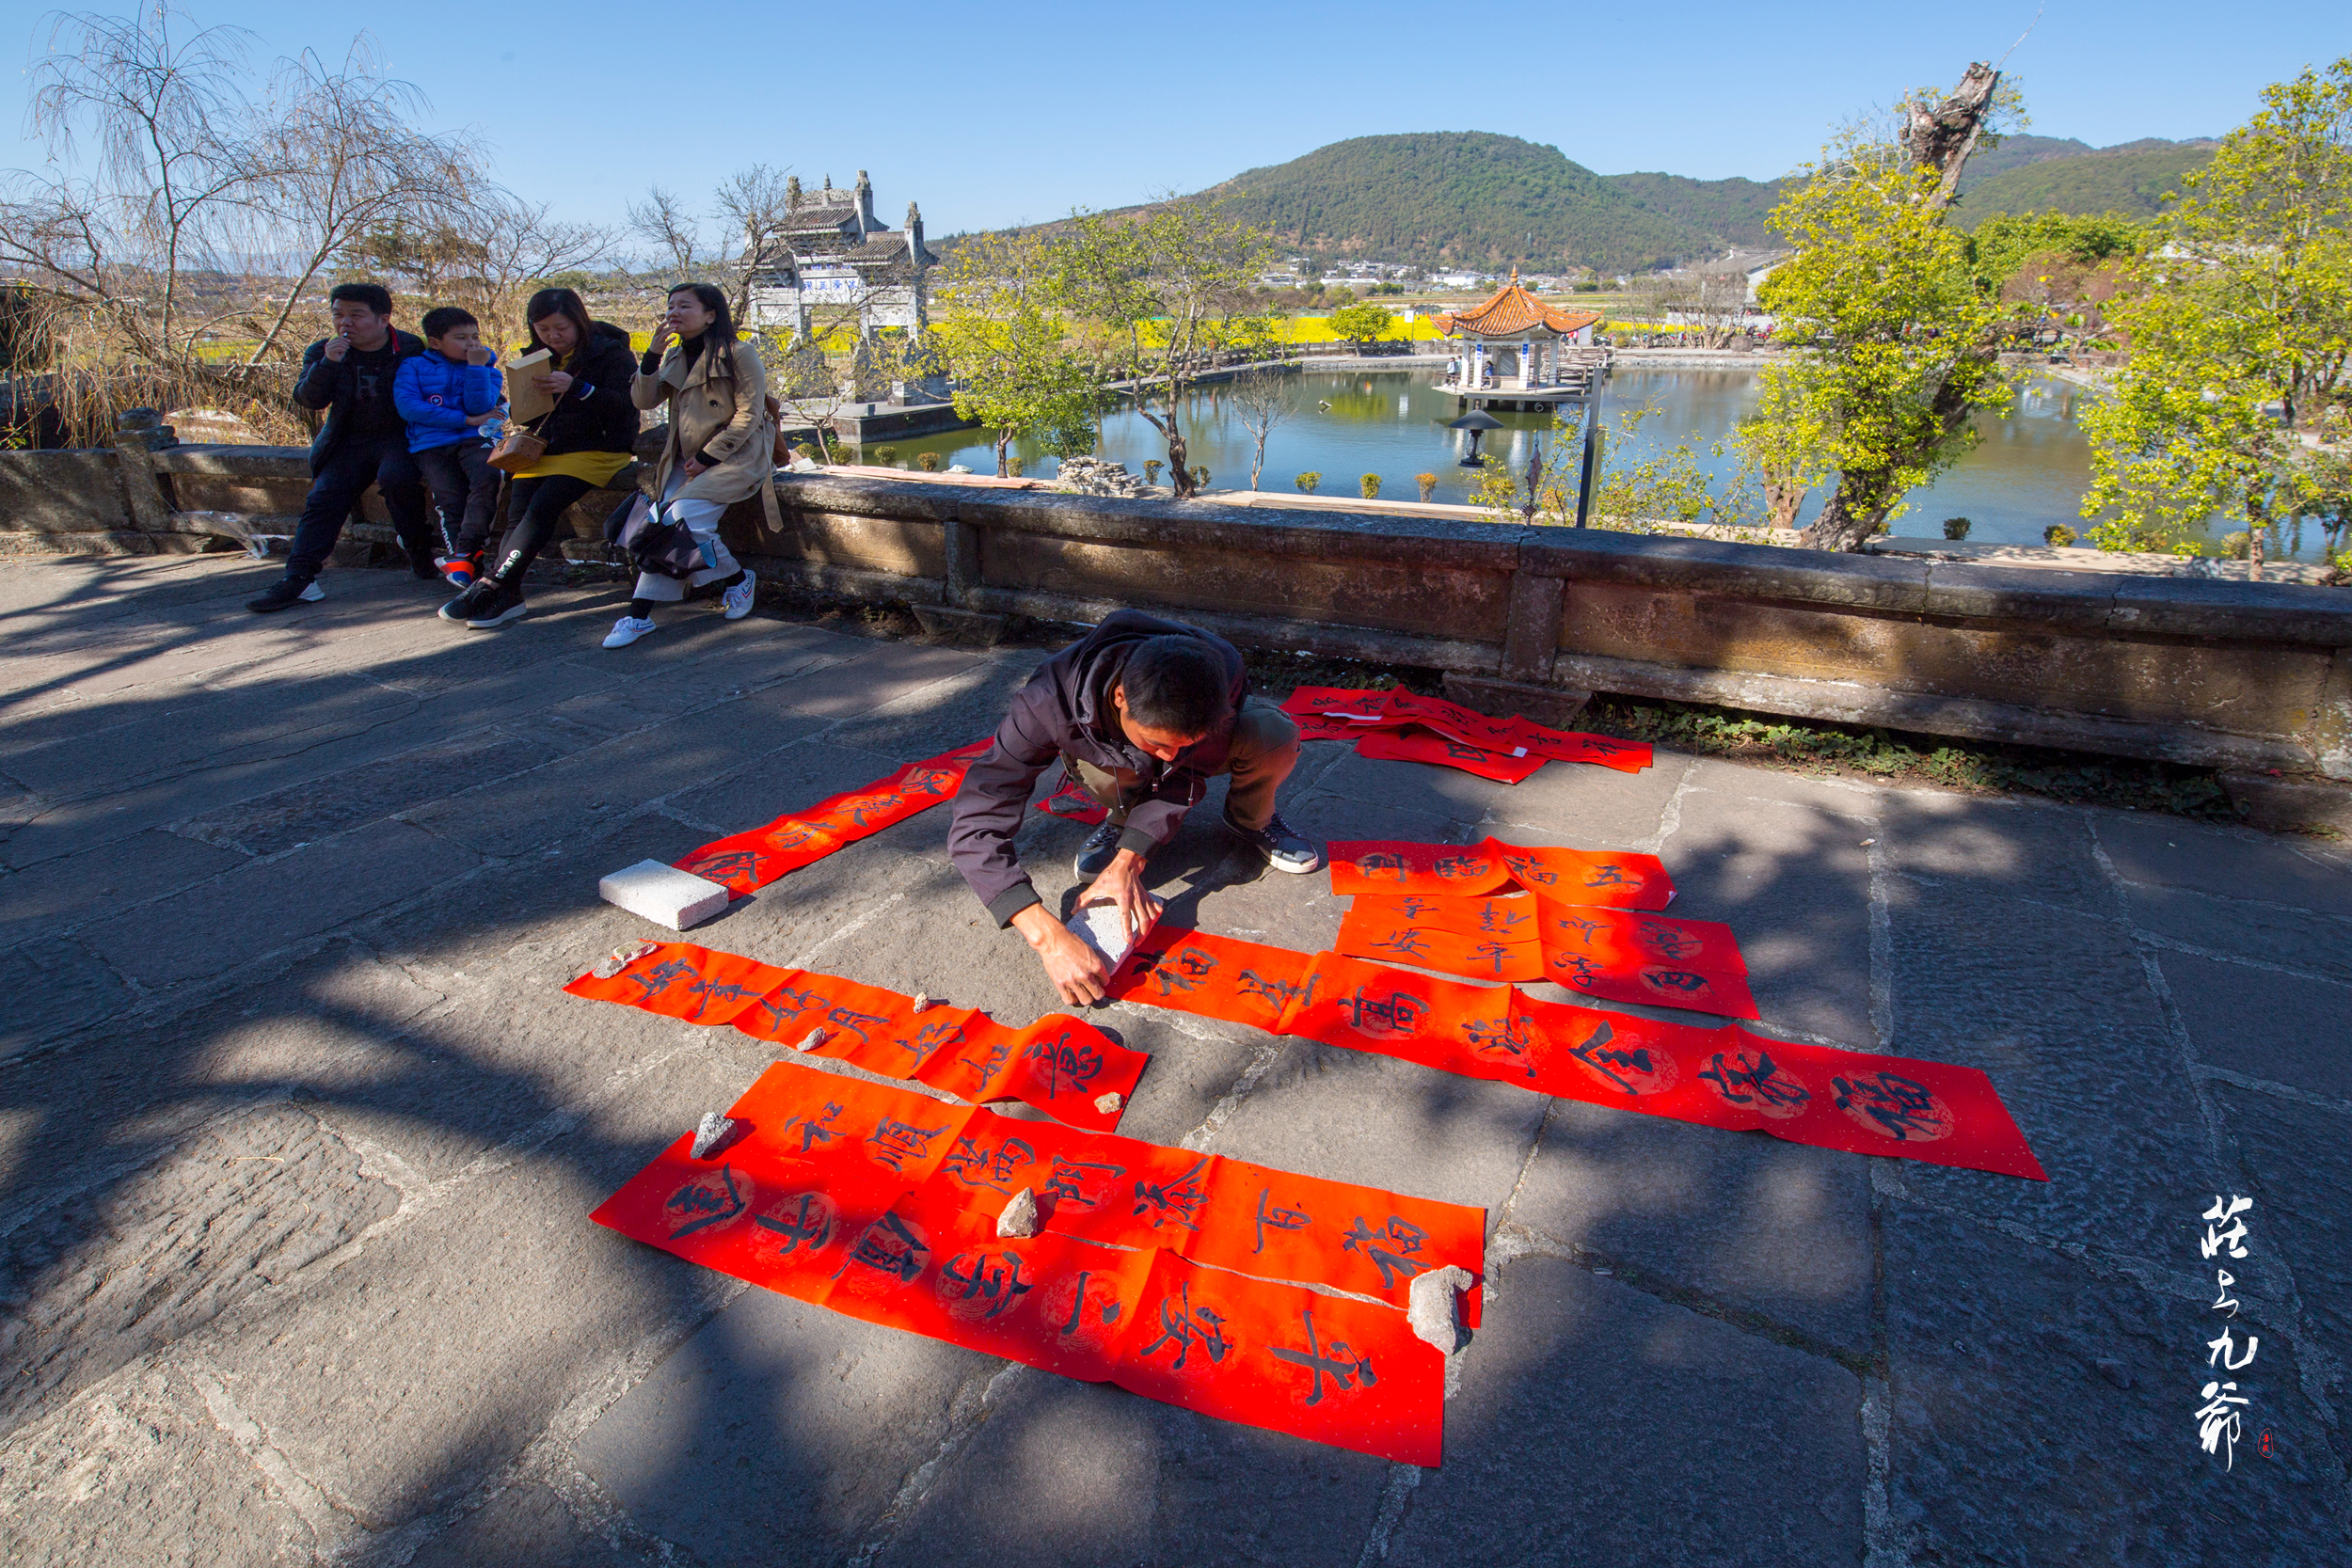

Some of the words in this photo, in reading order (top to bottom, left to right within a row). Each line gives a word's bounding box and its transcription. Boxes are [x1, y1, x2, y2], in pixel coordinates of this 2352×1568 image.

[1362, 852, 1643, 888] 五福臨門
[1391, 896, 1704, 960] 吉祥如意
[627, 957, 1104, 1100] 好年好月好如意
[1369, 927, 1716, 996] 四季平安
[1130, 946, 1936, 1142] 福星高照全家福
[784, 1100, 1433, 1289] 和順滿門添百福
[662, 1163, 1379, 1406] 平安二字值千金
